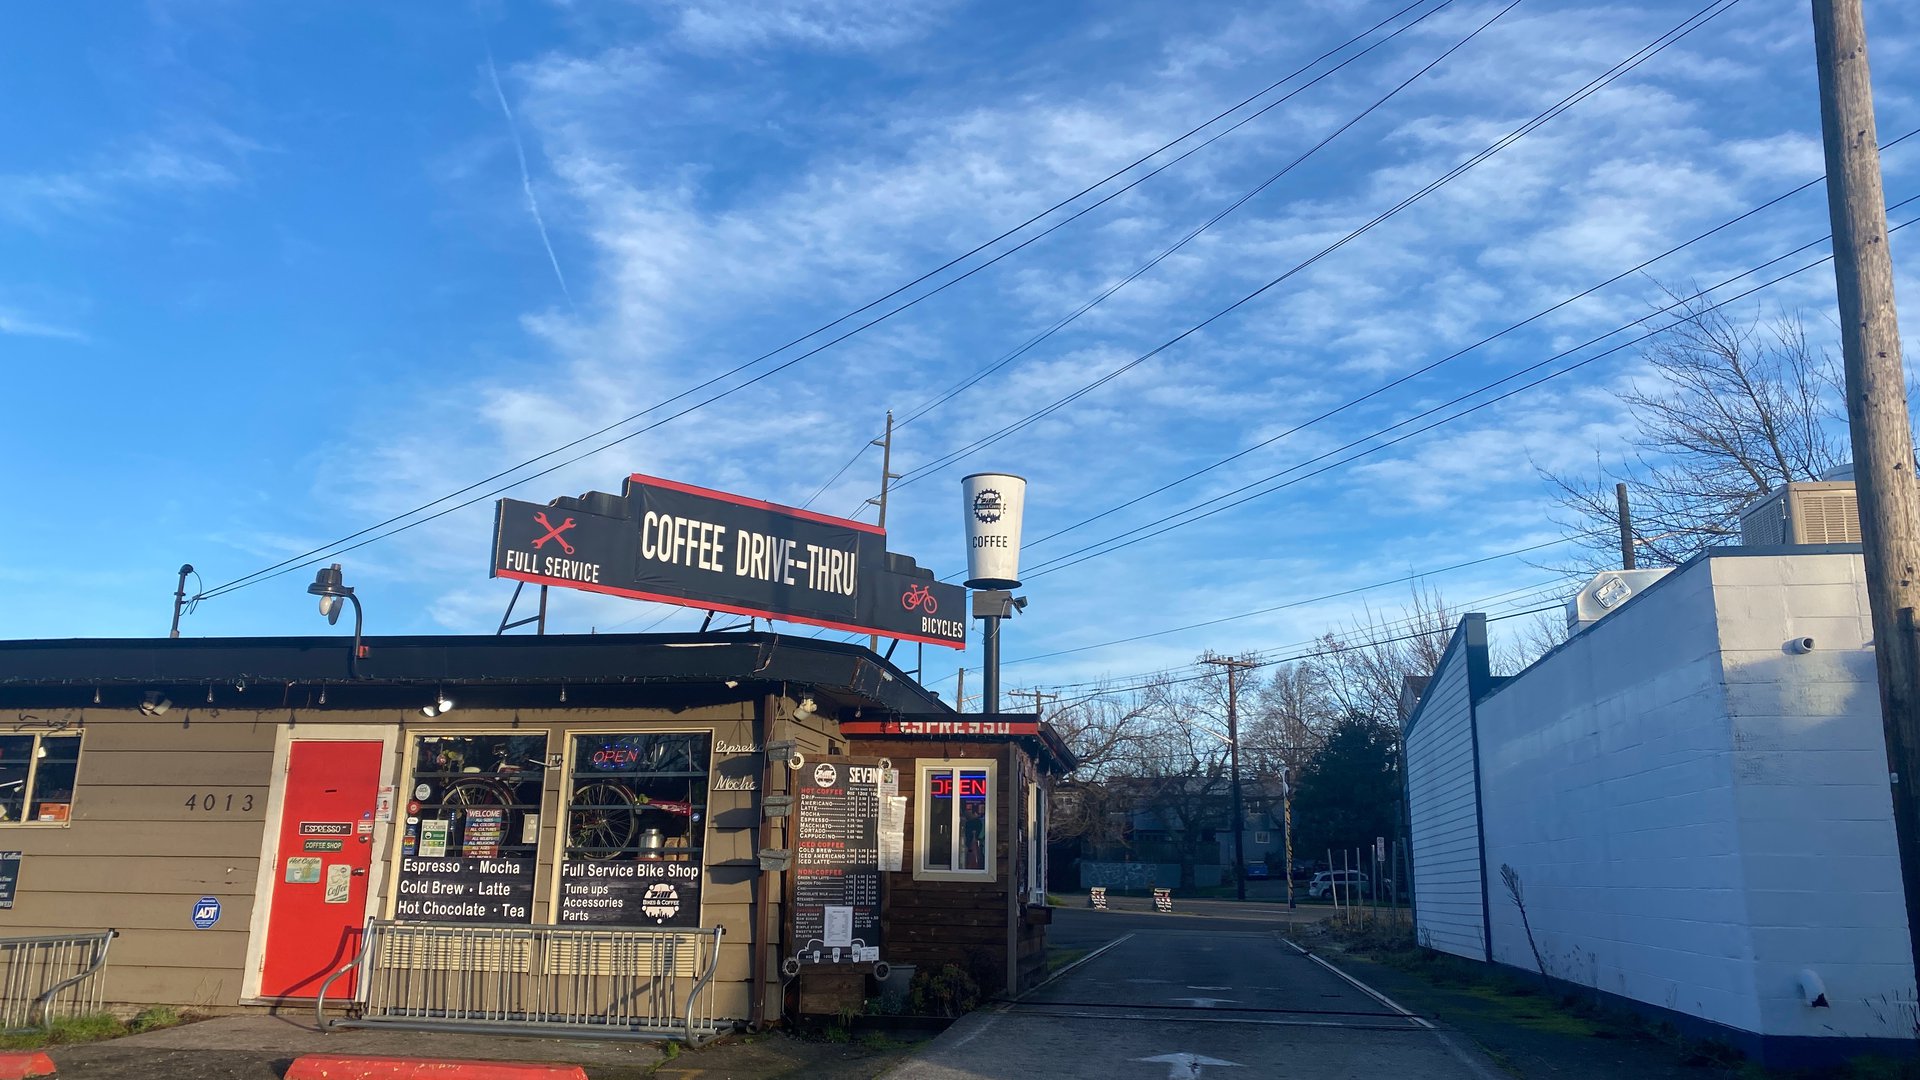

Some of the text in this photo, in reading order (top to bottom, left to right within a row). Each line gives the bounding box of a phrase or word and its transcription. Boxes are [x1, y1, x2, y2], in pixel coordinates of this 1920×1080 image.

[972, 535, 1008, 549] COFFEE
[641, 510, 856, 596] COFFEE DRIVE-THRU
[506, 549, 600, 584] FULL SERVICE
[921, 616, 963, 639] BICYCLES
[593, 749, 640, 763] OPEN
[930, 779, 986, 795] OPEN
[184, 793, 254, 812] 4013
[469, 810, 501, 818] WELCOME
[304, 825, 341, 834] ESPRESSO
[305, 841, 342, 850] COFFEE SHOP
[289, 857, 320, 866] Hot Coffee
[403, 858, 520, 875] Espresso Mocha
[562, 863, 699, 880] Full Service Bike Shop
[327, 884, 348, 897] Coffee
[400, 880, 511, 896] Cold Brew Latte
[564, 883, 609, 897] Tune ups
[397, 900, 525, 918] Hot Chocolate Tea
[563, 897, 624, 908] Accessories
[195, 906, 218, 919] ADT
[562, 910, 589, 921] Parts
